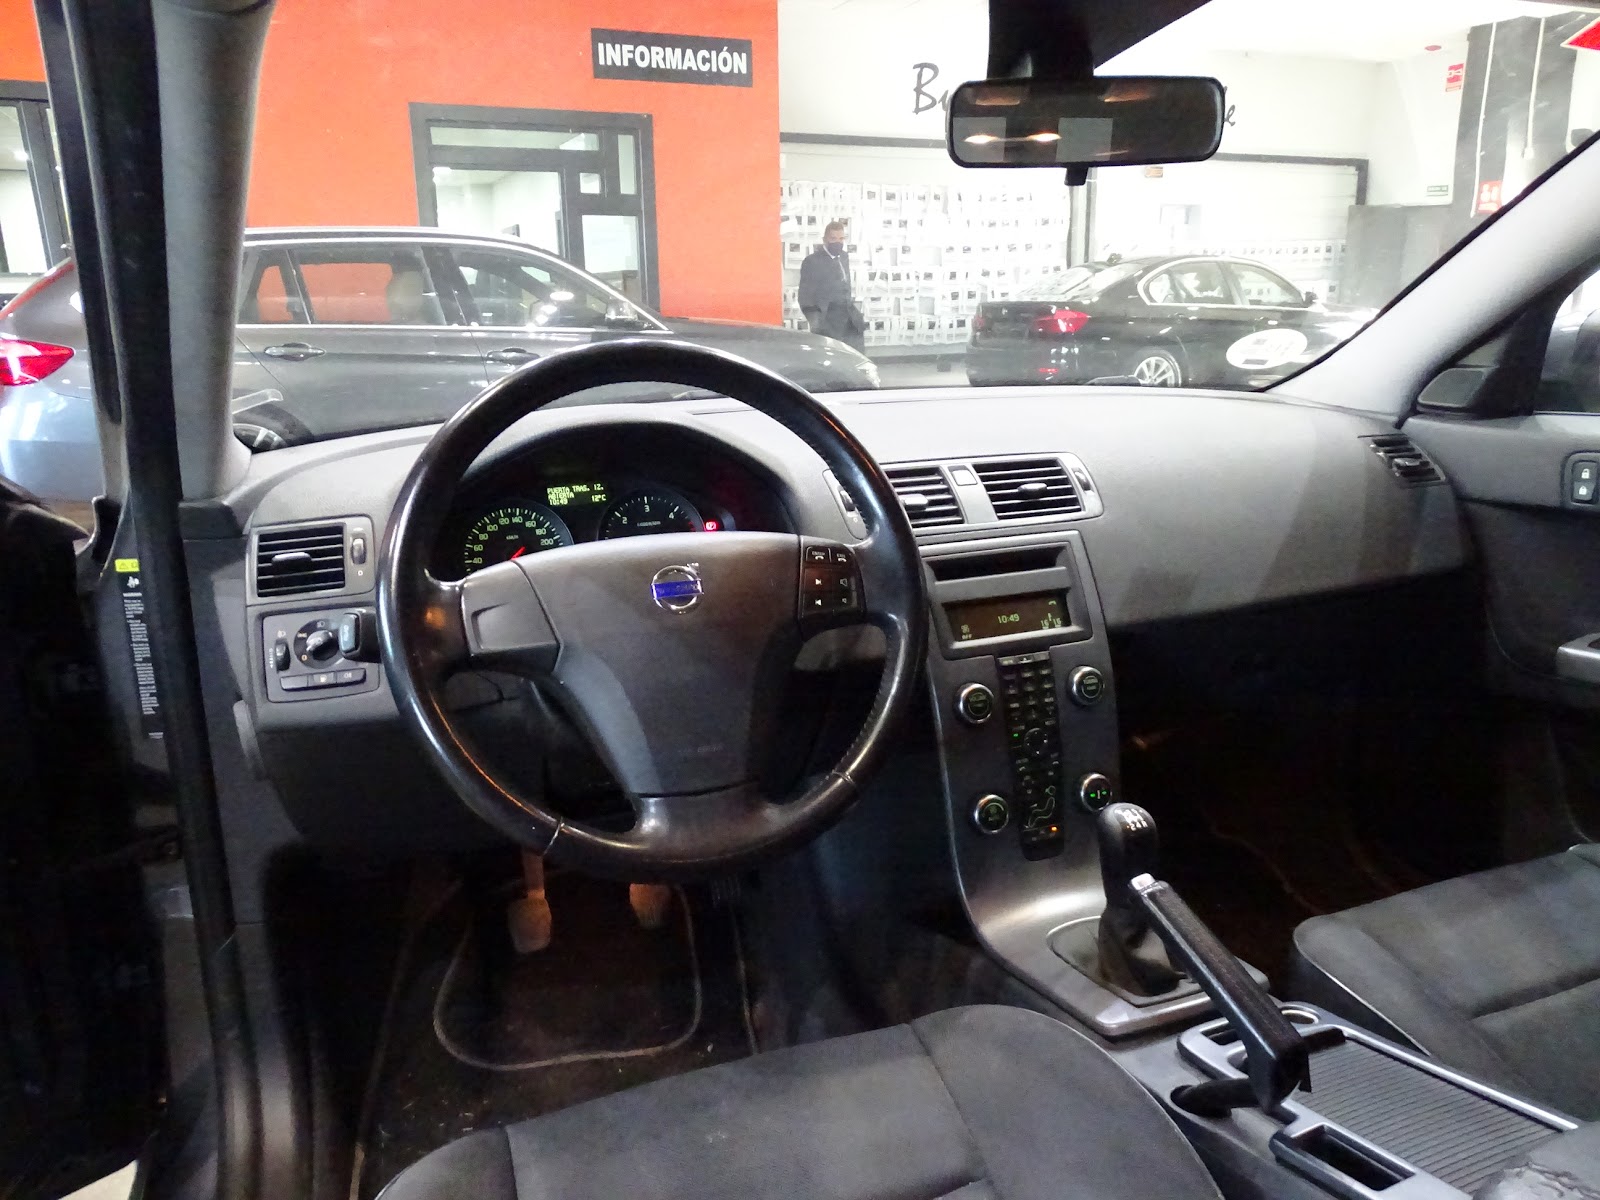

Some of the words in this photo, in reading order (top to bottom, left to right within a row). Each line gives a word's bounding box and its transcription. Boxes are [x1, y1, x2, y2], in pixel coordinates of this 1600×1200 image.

[597, 42, 748, 74] INFORMACIÓN
[644, 504, 650, 513] 3
[499, 517, 510, 525] 120
[525, 520, 536, 528] 160
[622, 516, 628, 524] 2
[473, 544, 484, 552] 60
[997, 613, 1020, 624] 10:49
